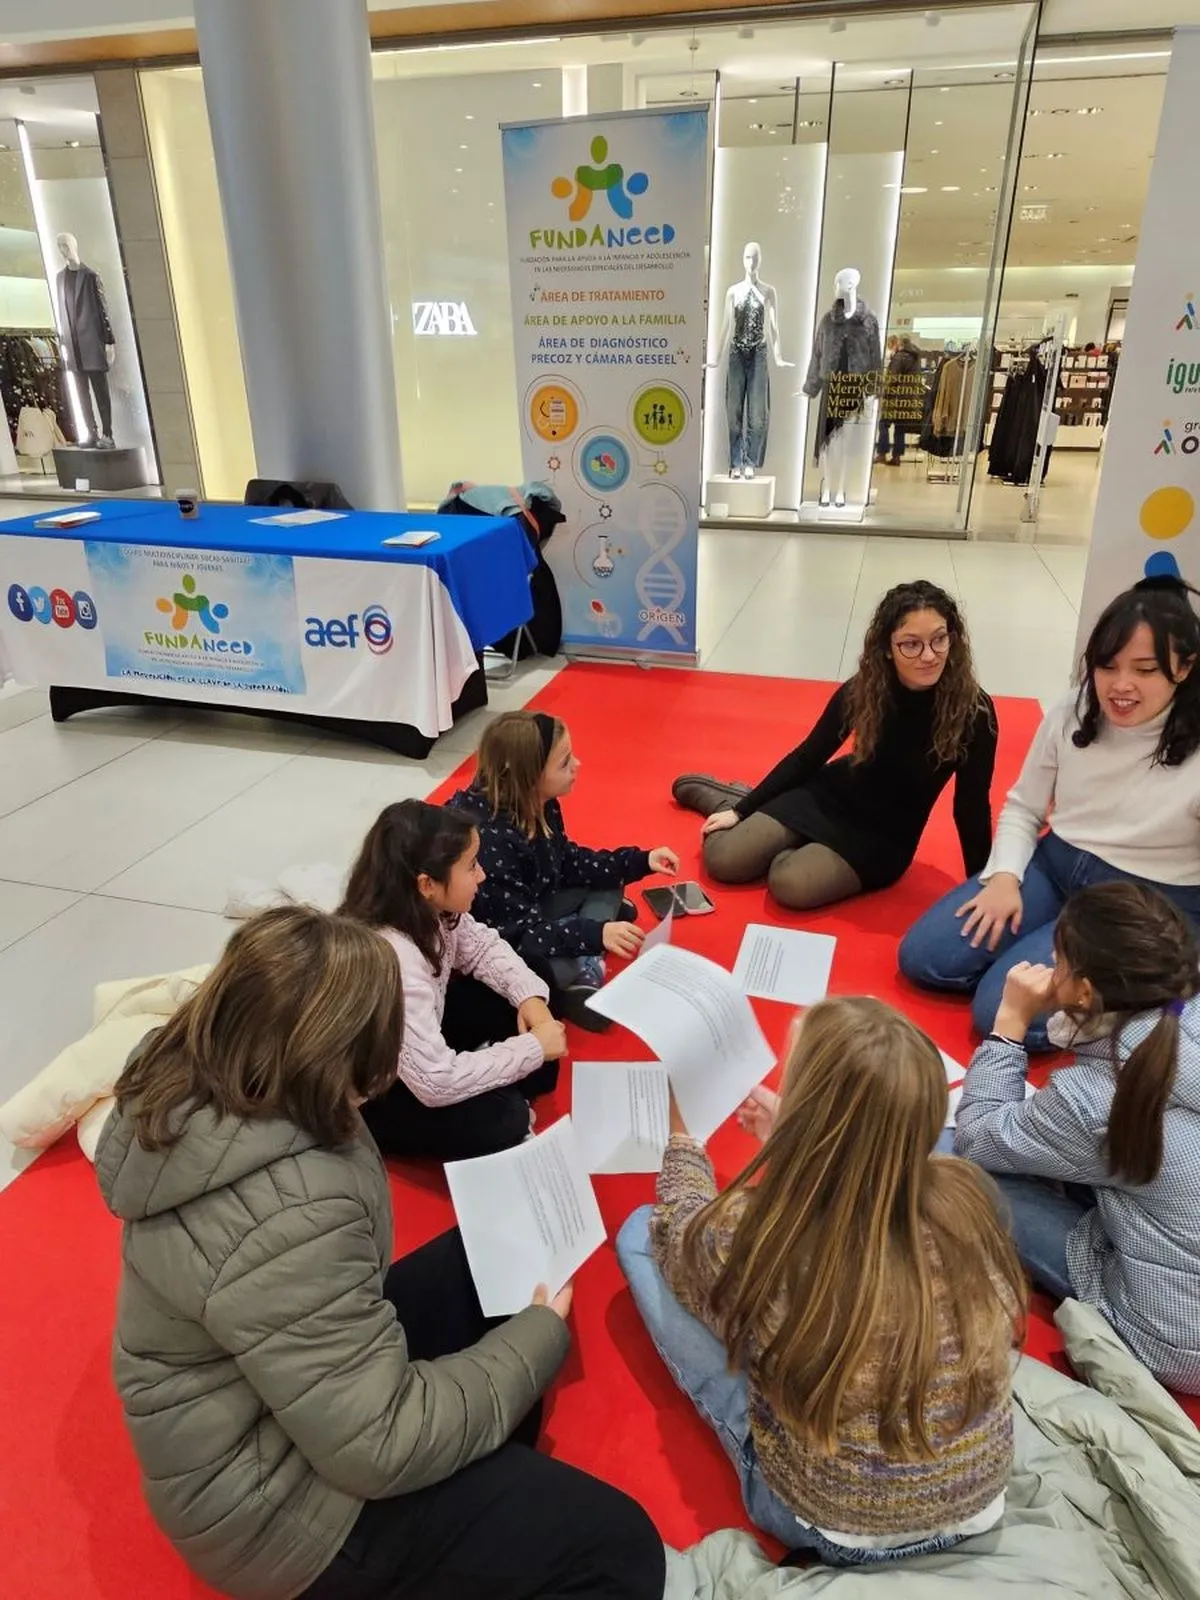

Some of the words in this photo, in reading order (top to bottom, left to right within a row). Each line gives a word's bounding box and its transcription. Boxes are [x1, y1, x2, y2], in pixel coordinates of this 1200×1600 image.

[540, 289, 568, 303] ÁREA
[571, 291, 587, 302] DE
[589, 290, 666, 301] TRATAMIENTO
[412, 301, 478, 336] ZARA
[524, 312, 550, 326] ÁREA
[552, 315, 568, 326] DE
[570, 314, 609, 326] APOYO
[611, 315, 620, 325] A
[622, 314, 637, 326] LA
[639, 314, 687, 326] FAMILIA
[538, 336, 568, 348] ÁREA
[570, 338, 586, 348] DE
[590, 335, 668, 348] DIAGNÓSTICO
[532, 354, 572, 364] PRECOZ
[574, 354, 583, 364] Y
[585, 352, 632, 364] CÁMARA
[635, 354, 677, 365] GESEEL
[1184, 422, 1200, 433] gr
[304, 614, 360, 648] aef
